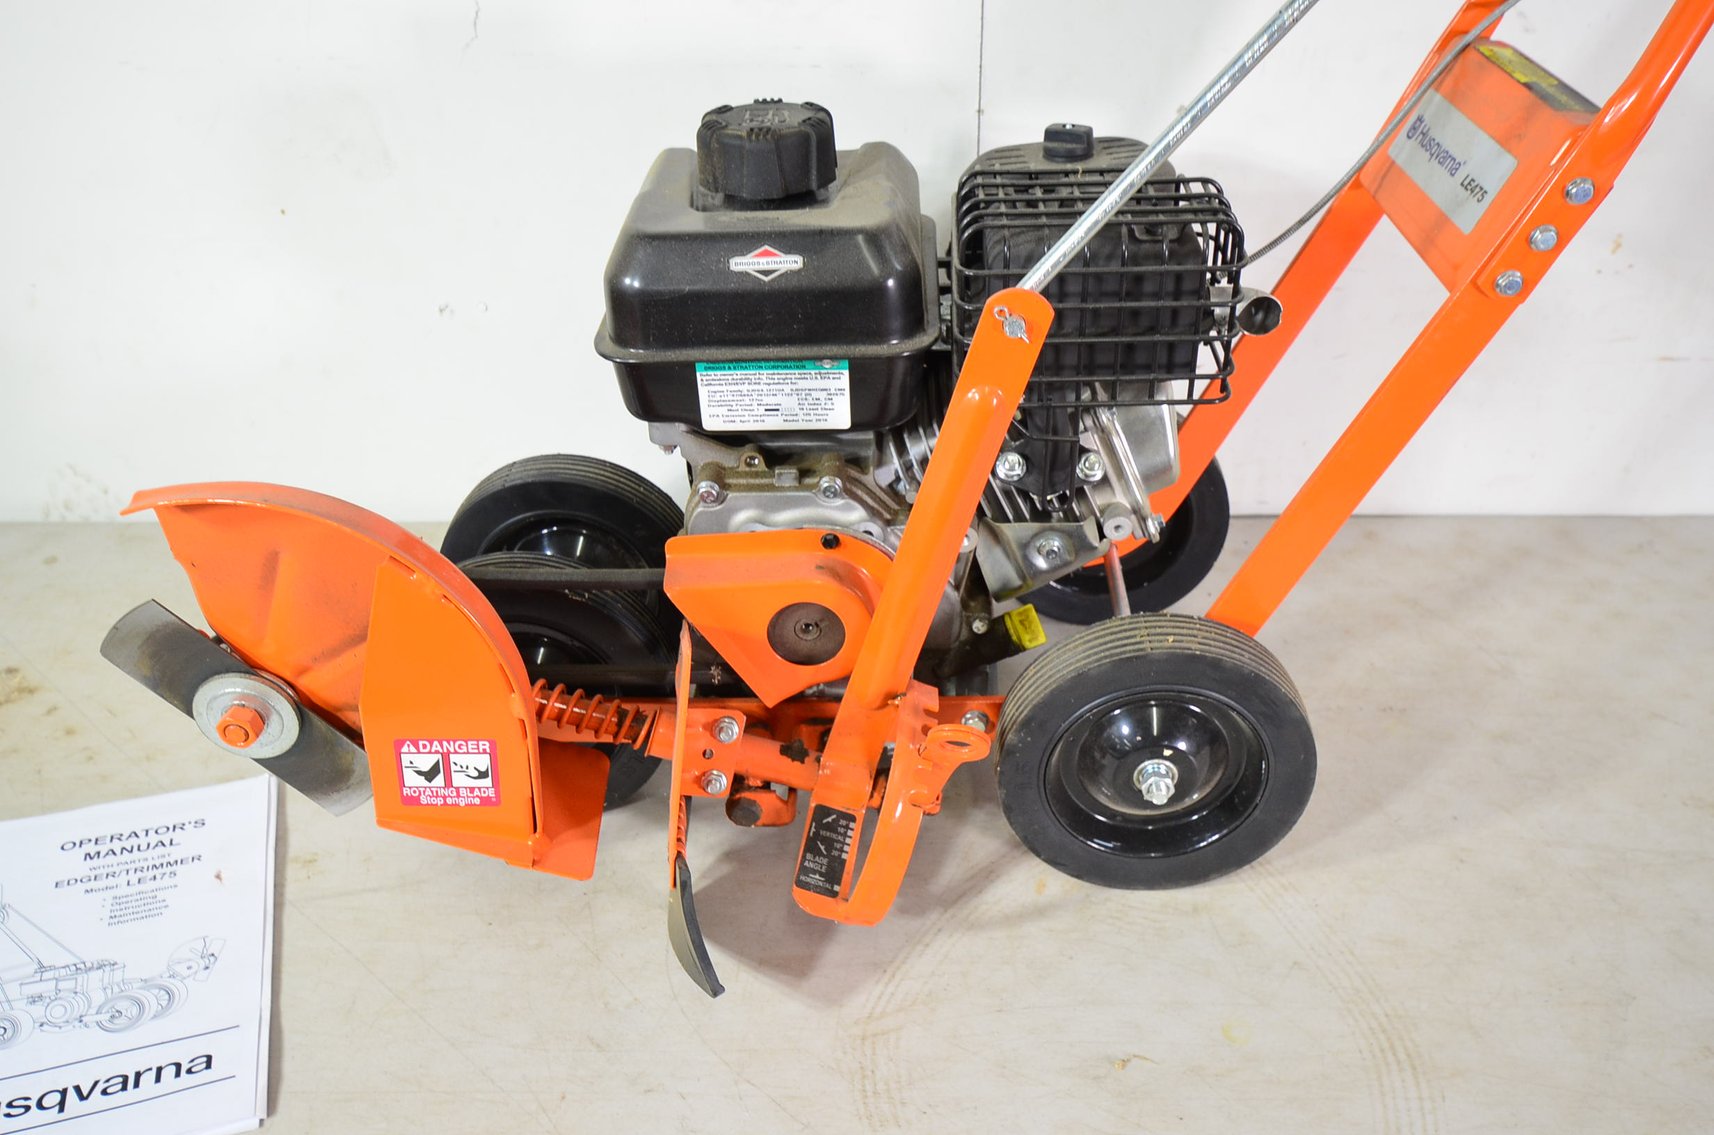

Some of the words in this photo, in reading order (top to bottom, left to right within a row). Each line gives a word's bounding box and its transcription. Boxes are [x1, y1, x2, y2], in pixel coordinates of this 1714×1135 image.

[1414, 124, 1462, 177] Husqvarna
[1460, 174, 1488, 203] LE475
[418, 740, 490, 753] DANGER
[402, 787, 457, 797] ROTATING
[459, 787, 496, 797] BLADE
[419, 796, 444, 806] Stop
[446, 796, 481, 807] engine
[60, 818, 206, 852] OPERATOR'S
[820, 829, 845, 841] VERTICAL
[83, 838, 181, 862] MANUAL
[89, 863, 114, 872] WITH
[116, 857, 149, 867] PARTS
[151, 853, 172, 861] LIST
[803, 860, 828, 873] ANGLE
[805, 852, 829, 866] BLADE
[54, 854, 203, 889] EDGER/TRIMMER
[84, 883, 122, 895] Model:
[126, 870, 177, 888] LE475
[799, 875, 832, 890] HORIZONTAL
[110, 894, 157, 908] Operating
[112, 884, 178, 901] Specifications
[0, 1054, 213, 1119] sqvarna
